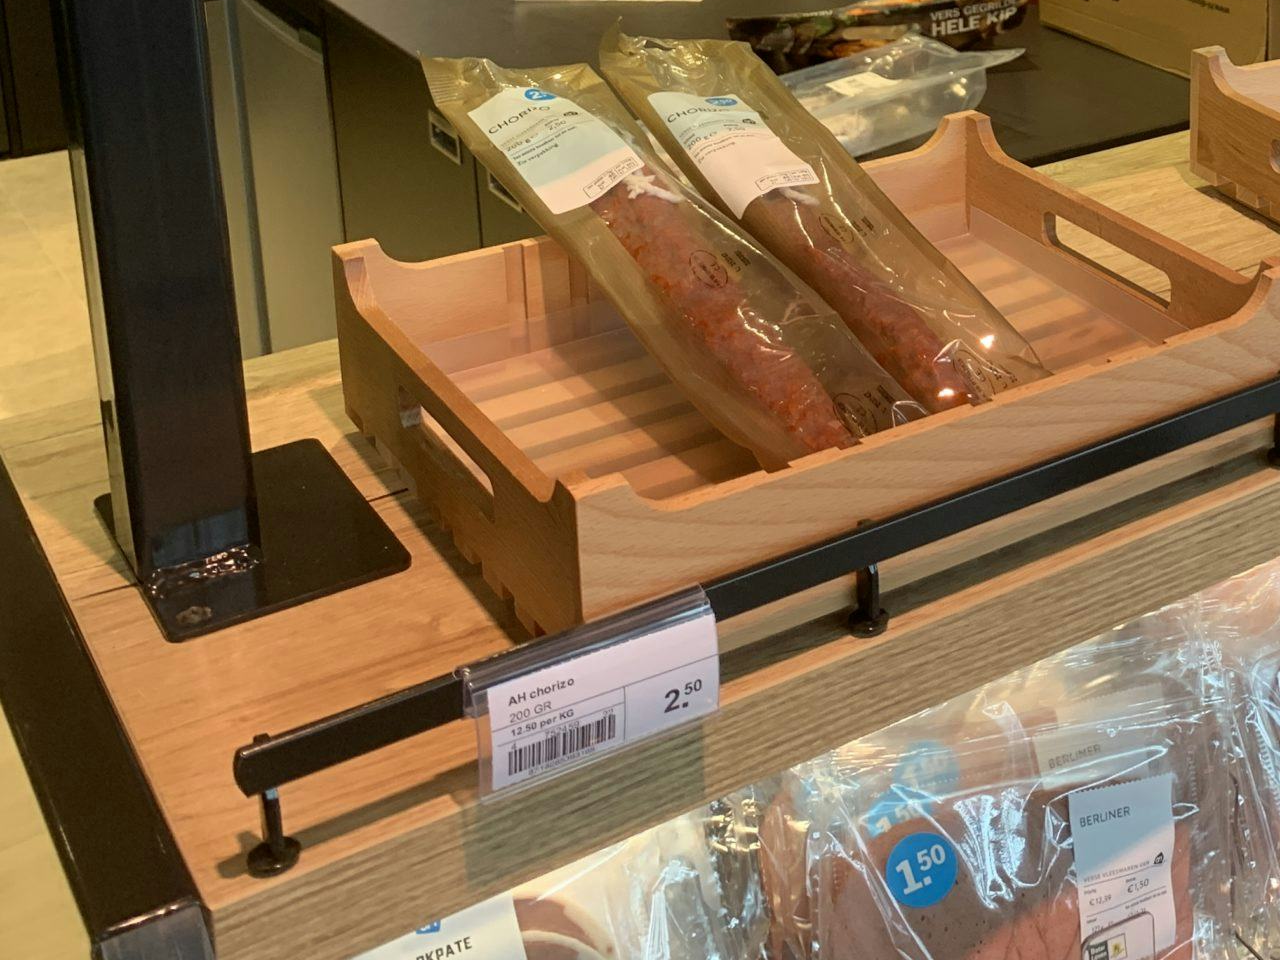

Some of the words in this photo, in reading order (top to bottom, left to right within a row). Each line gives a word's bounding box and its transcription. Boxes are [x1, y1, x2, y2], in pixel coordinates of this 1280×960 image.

[930, 7, 960, 20] VERS
[932, 16, 981, 38] HELE
[508, 693, 527, 708] AH
[529, 677, 576, 700] chorizo
[664, 678, 703, 714] 2.50
[509, 708, 532, 724] 200
[534, 700, 553, 714] GR
[511, 722, 538, 738] 12.50
[540, 715, 557, 730] per
[559, 708, 575, 721] KG
[1079, 805, 1132, 828] BERLINER
[895, 844, 947, 897] 1.50
